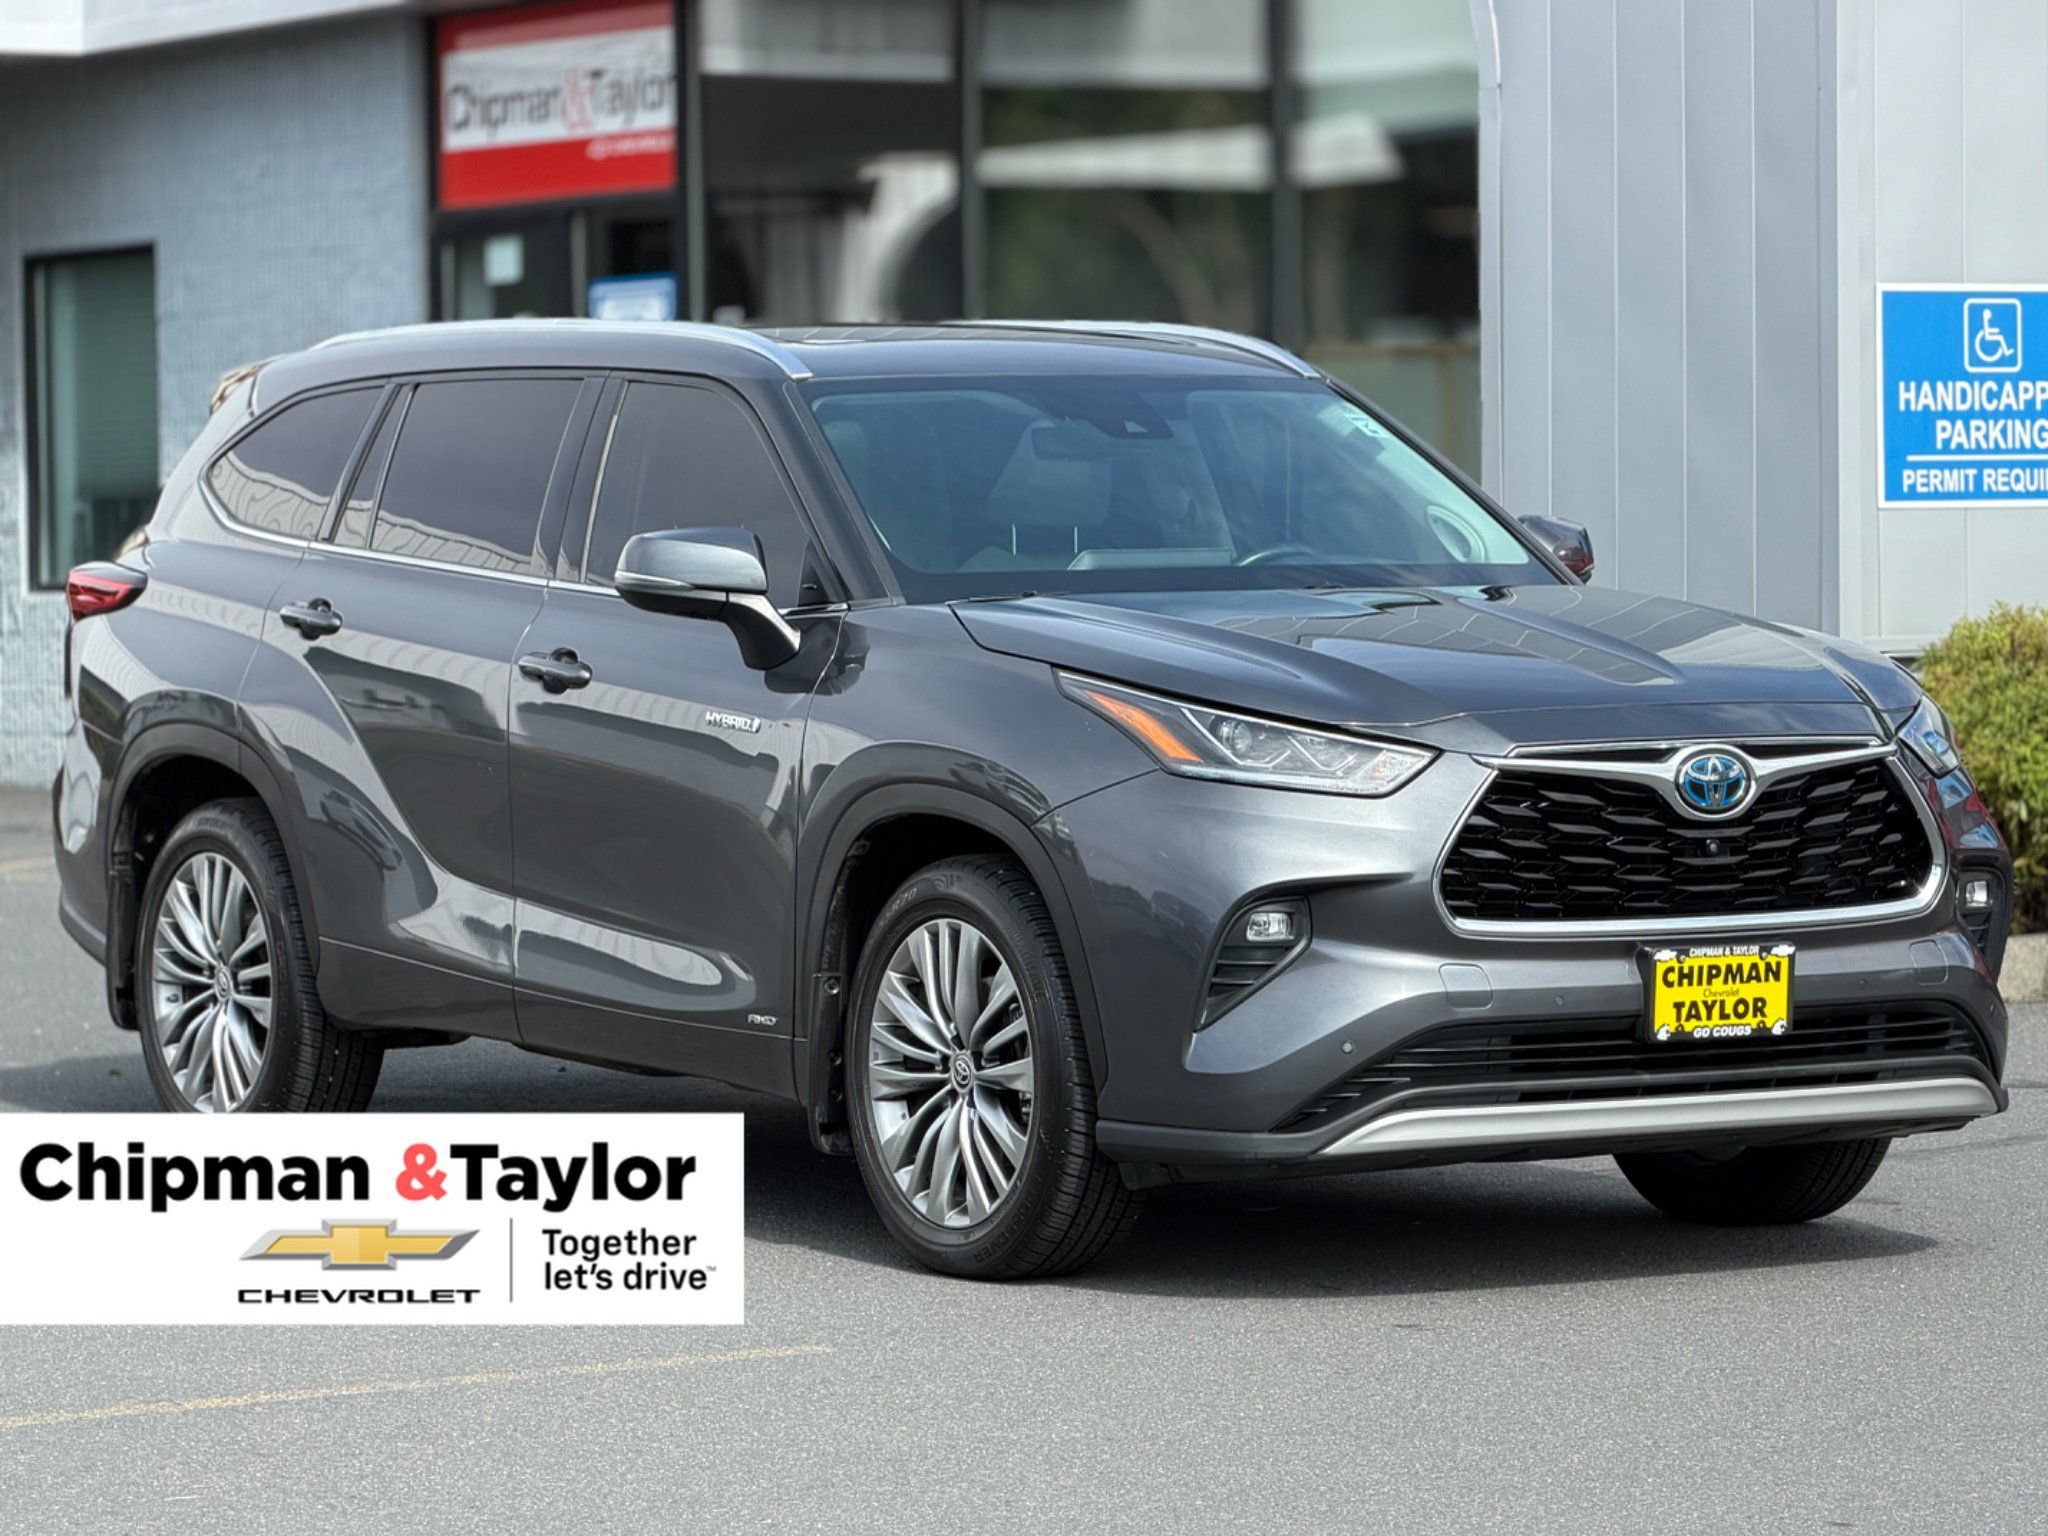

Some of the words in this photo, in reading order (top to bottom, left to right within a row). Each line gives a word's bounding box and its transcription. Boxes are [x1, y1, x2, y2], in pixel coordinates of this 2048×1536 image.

[1936, 418, 2048, 449] PARKING
[1903, 469, 1977, 493] PERMIT
[1983, 467, 2048, 493] REQUI
[1689, 947, 1724, 957] CHIPMAN
[1733, 945, 1759, 955] TAYLOR
[1662, 961, 1781, 988] CHIPMAN
[1703, 987, 1740, 998] Chevrolet
[1673, 997, 1767, 1023] TAYLOR
[1693, 1027, 1710, 1038] GO
[1713, 1025, 1751, 1037] COUGS
